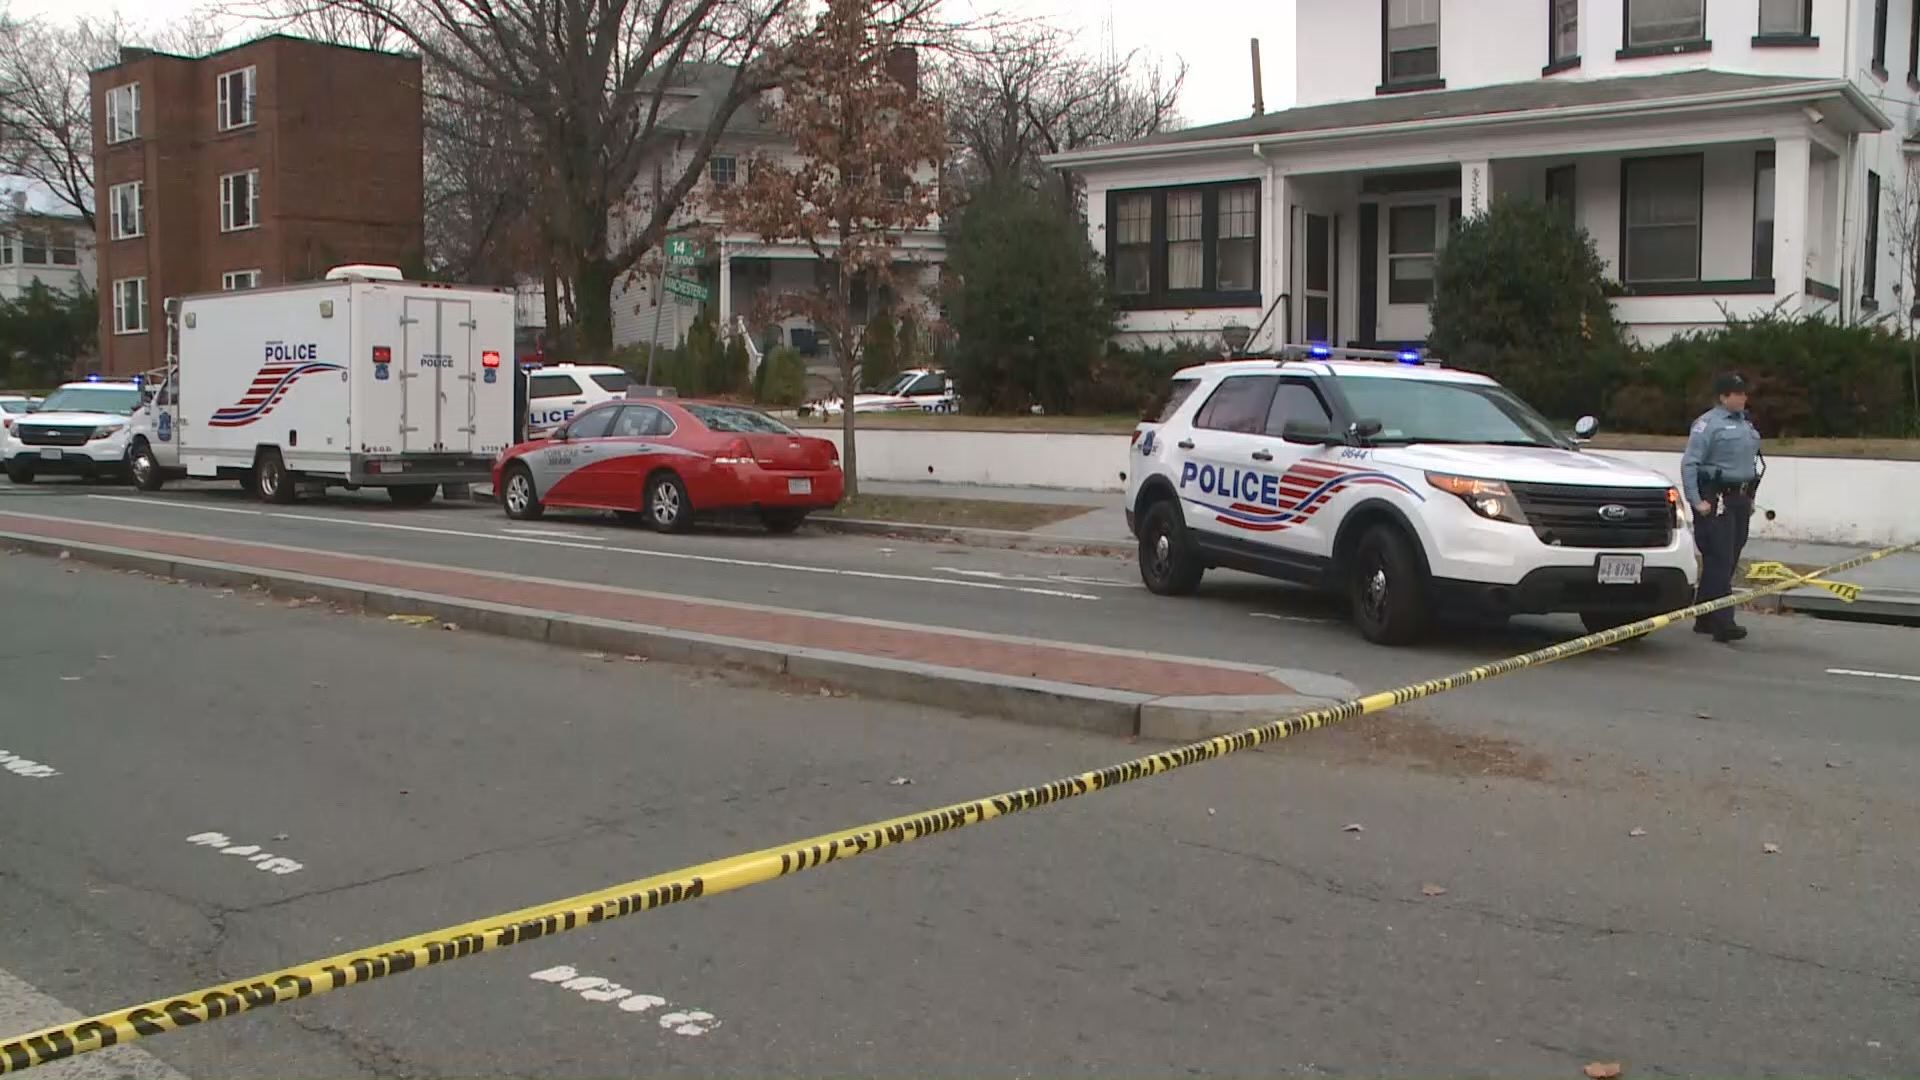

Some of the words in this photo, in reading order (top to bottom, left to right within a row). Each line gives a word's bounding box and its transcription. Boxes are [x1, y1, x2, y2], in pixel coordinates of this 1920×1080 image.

[672, 240, 685, 255] 14
[265, 344, 317, 361] POLICE
[420, 359, 454, 368] POLICE
[1180, 462, 1279, 506] POLICE
[126, 973, 313, 1037] CROSS
